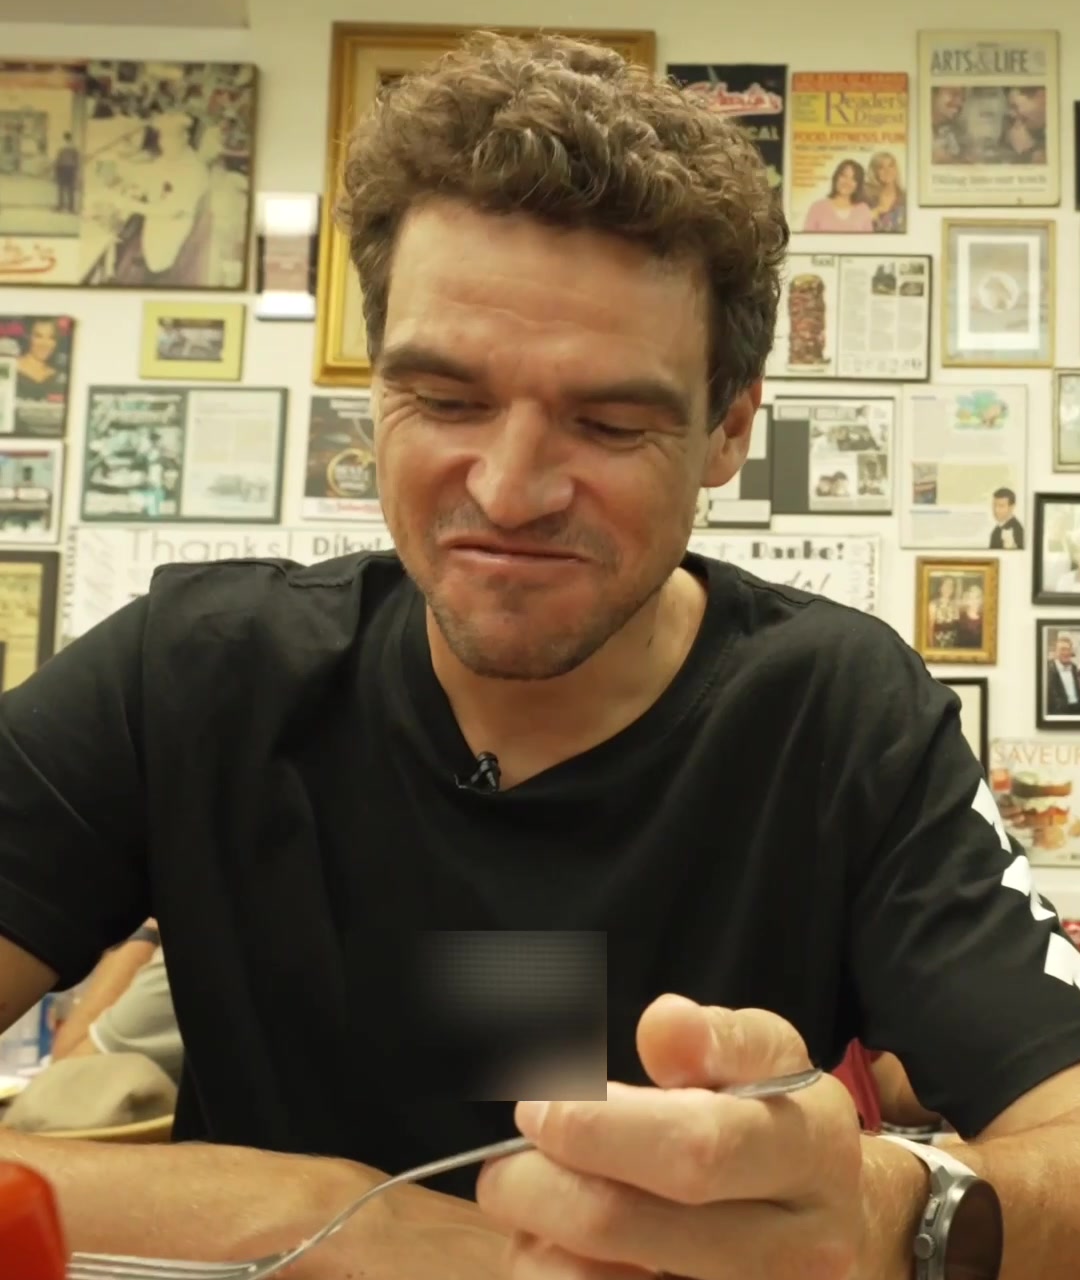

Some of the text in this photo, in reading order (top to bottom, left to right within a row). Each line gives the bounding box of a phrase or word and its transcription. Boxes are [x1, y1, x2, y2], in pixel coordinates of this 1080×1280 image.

[995, 50, 1029, 73] LIFE
[126, 529, 293, 565] Thanks!
[751, 540, 844, 560] Danke!
